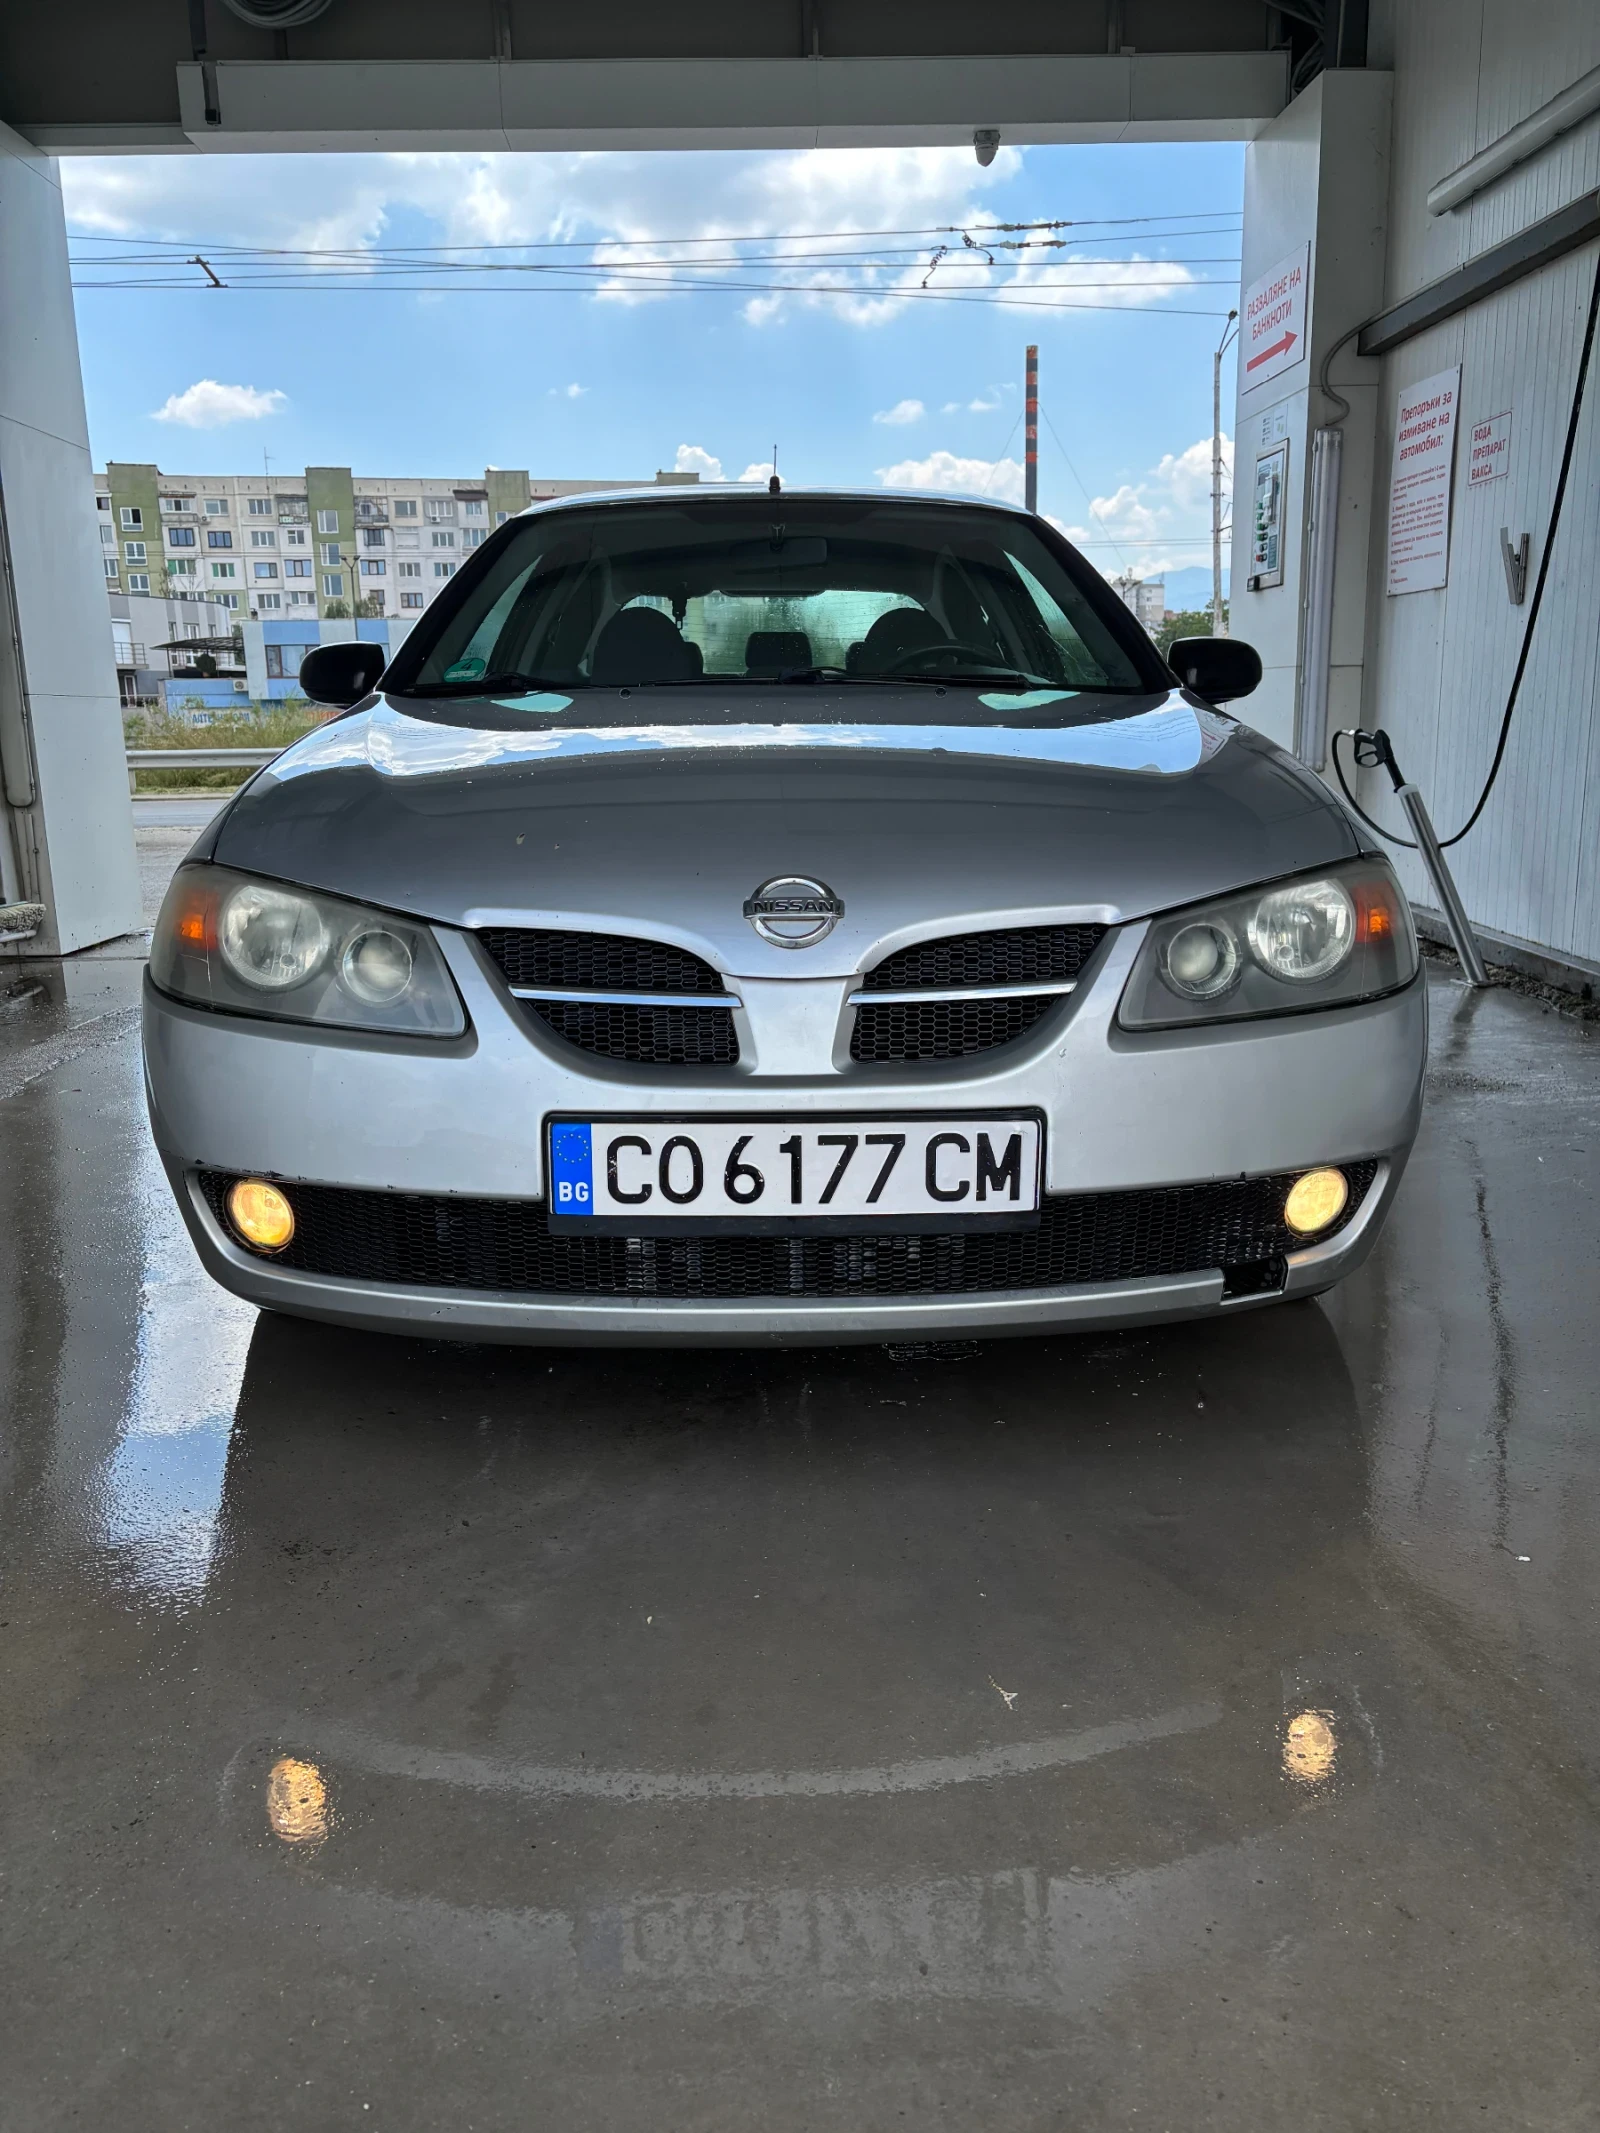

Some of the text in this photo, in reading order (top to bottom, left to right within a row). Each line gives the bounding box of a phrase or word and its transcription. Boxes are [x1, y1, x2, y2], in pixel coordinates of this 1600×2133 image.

[1247, 266, 1301, 320] РАЗВАЛЯНЕ НА
[1252, 298, 1292, 341] БАНКНОТИ
[1401, 391, 1452, 425] Препоръки за
[1399, 412, 1450, 442] измиване на
[1474, 425, 1491, 442] ВОДА
[1400, 434, 1444, 461] автомобил:
[1473, 438, 1506, 461] ПРЕПАРАТ
[1471, 463, 1492, 480] ВАКСА
[461, 659, 473, 670] 4
[753, 900, 834, 912] NISSAN
[724, 1134, 906, 1204] 6177
[926, 1132, 1022, 1202] CM
[559, 1181, 589, 1202] BG
